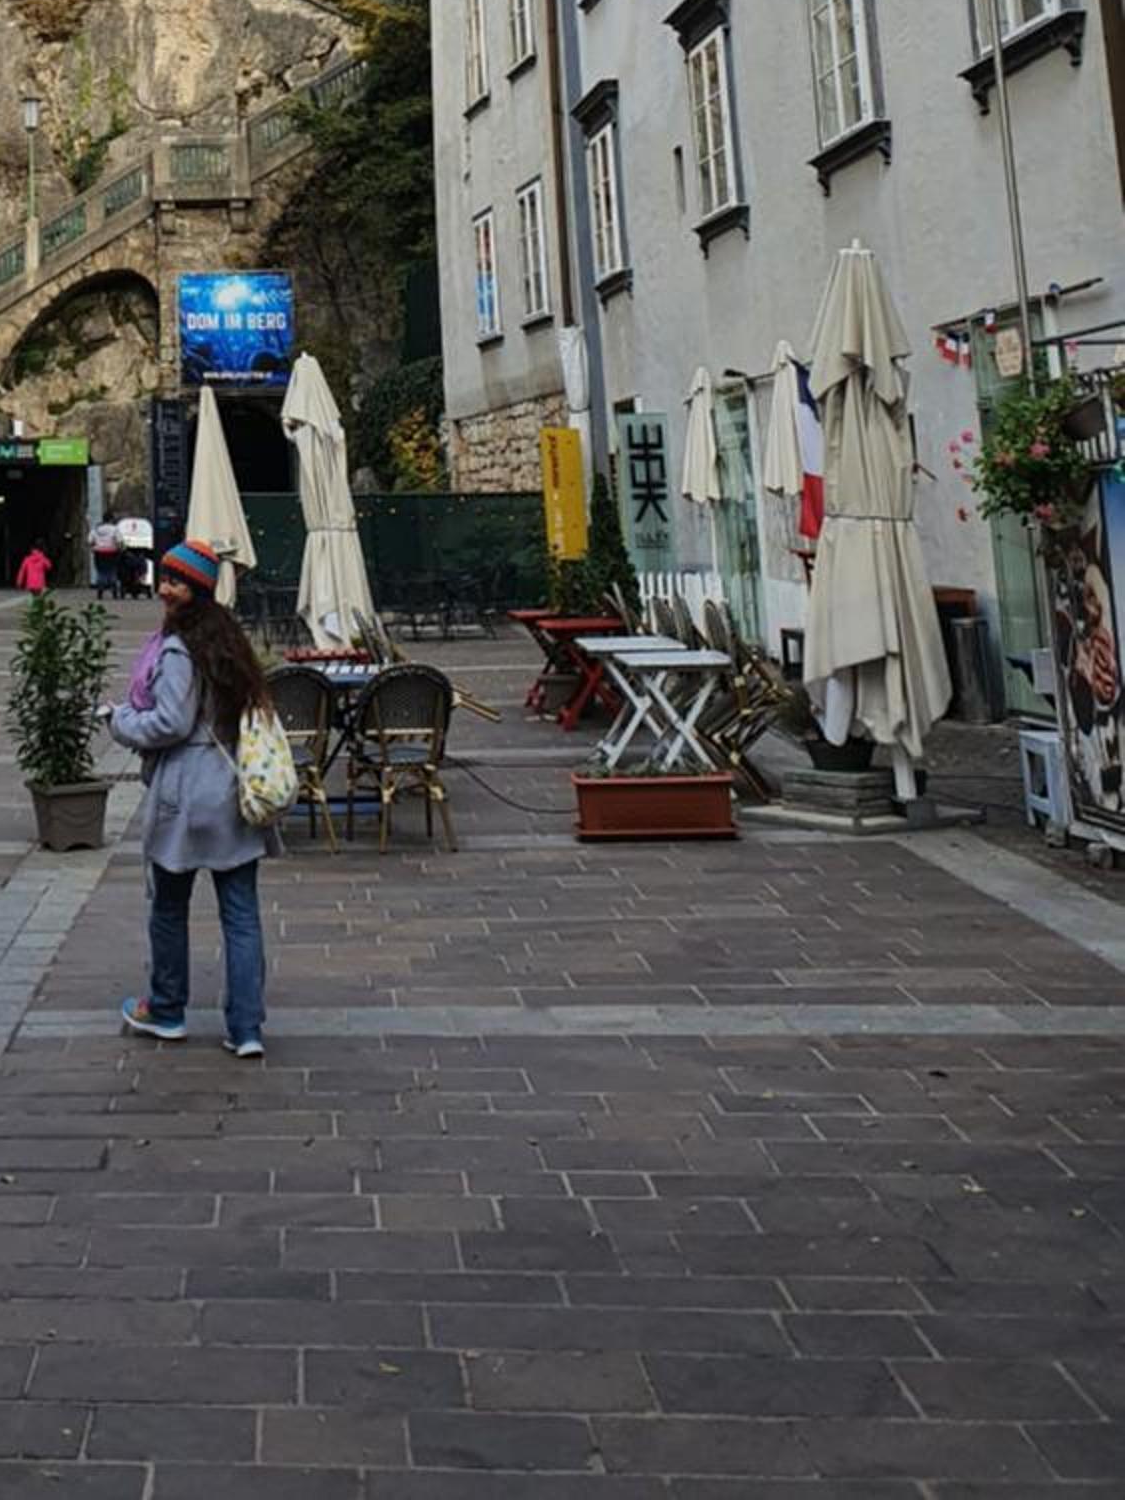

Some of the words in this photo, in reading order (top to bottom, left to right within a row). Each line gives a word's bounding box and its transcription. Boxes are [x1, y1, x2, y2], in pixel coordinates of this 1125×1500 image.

[187, 312, 219, 330] DOM
[224, 312, 242, 330] IM
[246, 312, 287, 330] BERG
